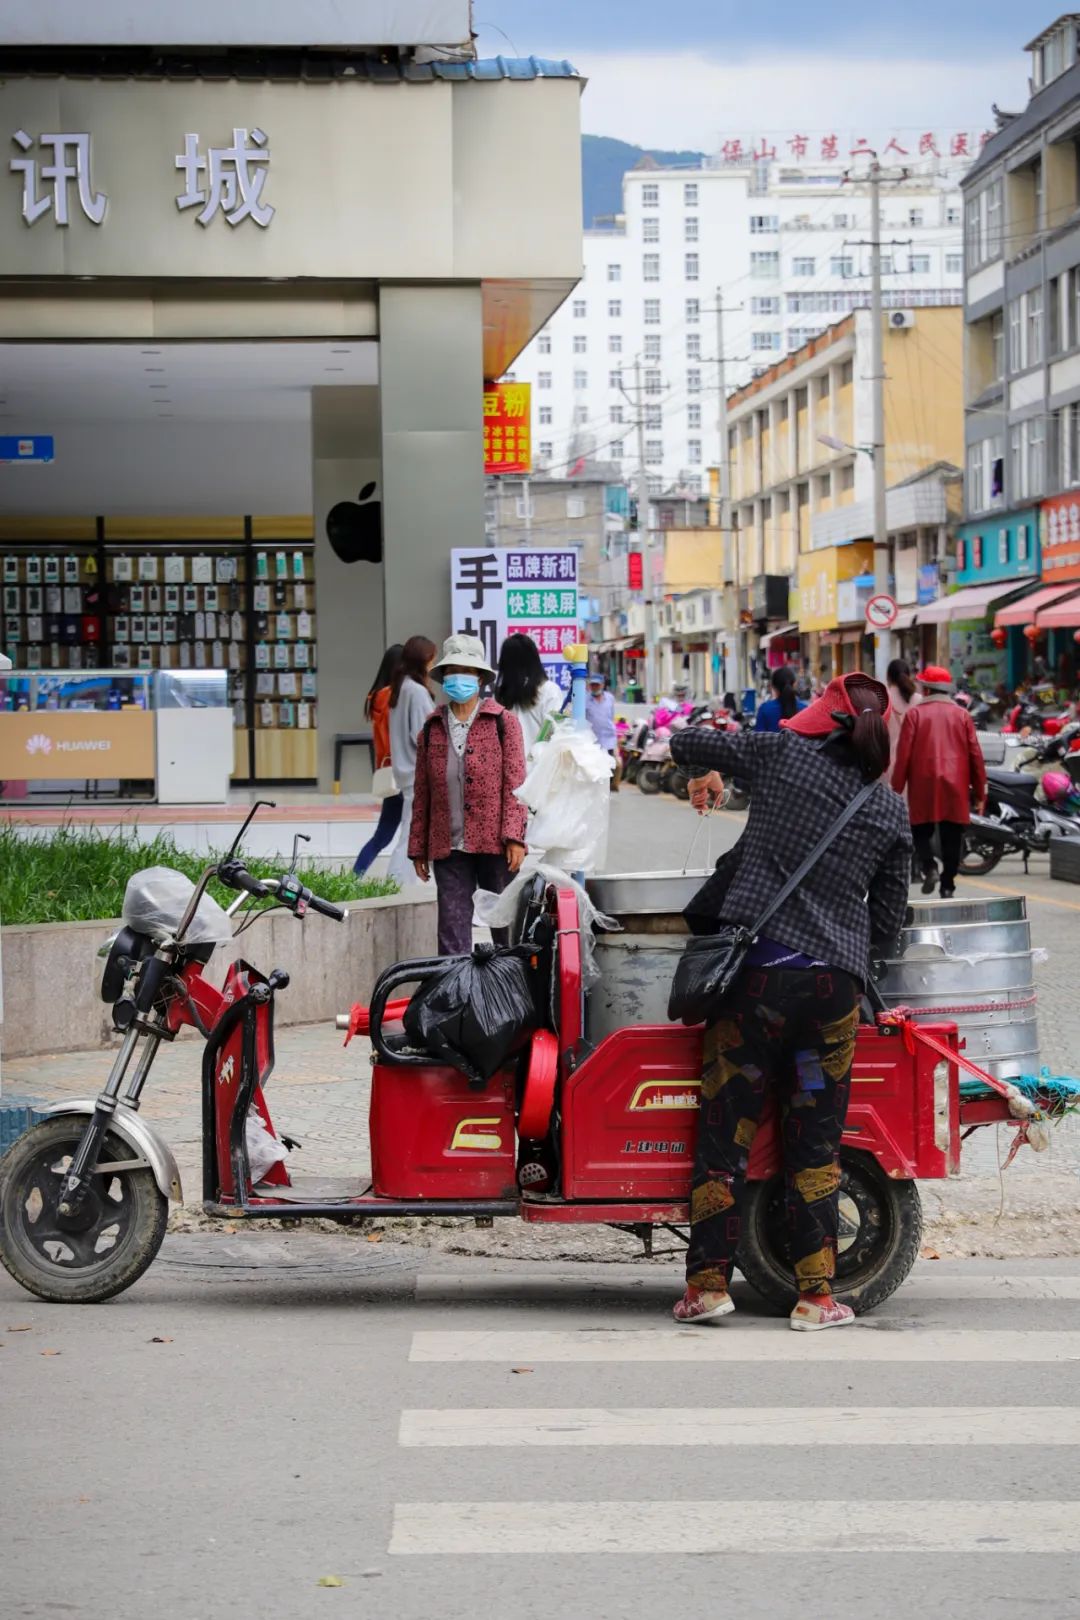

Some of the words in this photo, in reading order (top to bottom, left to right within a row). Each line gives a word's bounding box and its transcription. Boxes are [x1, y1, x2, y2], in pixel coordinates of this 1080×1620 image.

[9, 128, 277, 228] 讯城
[507, 556, 577, 579] 品牌新机
[508, 592, 577, 615] 快速换屏
[508, 627, 577, 652] 板精修
[56, 740, 111, 752] HUAWEI
